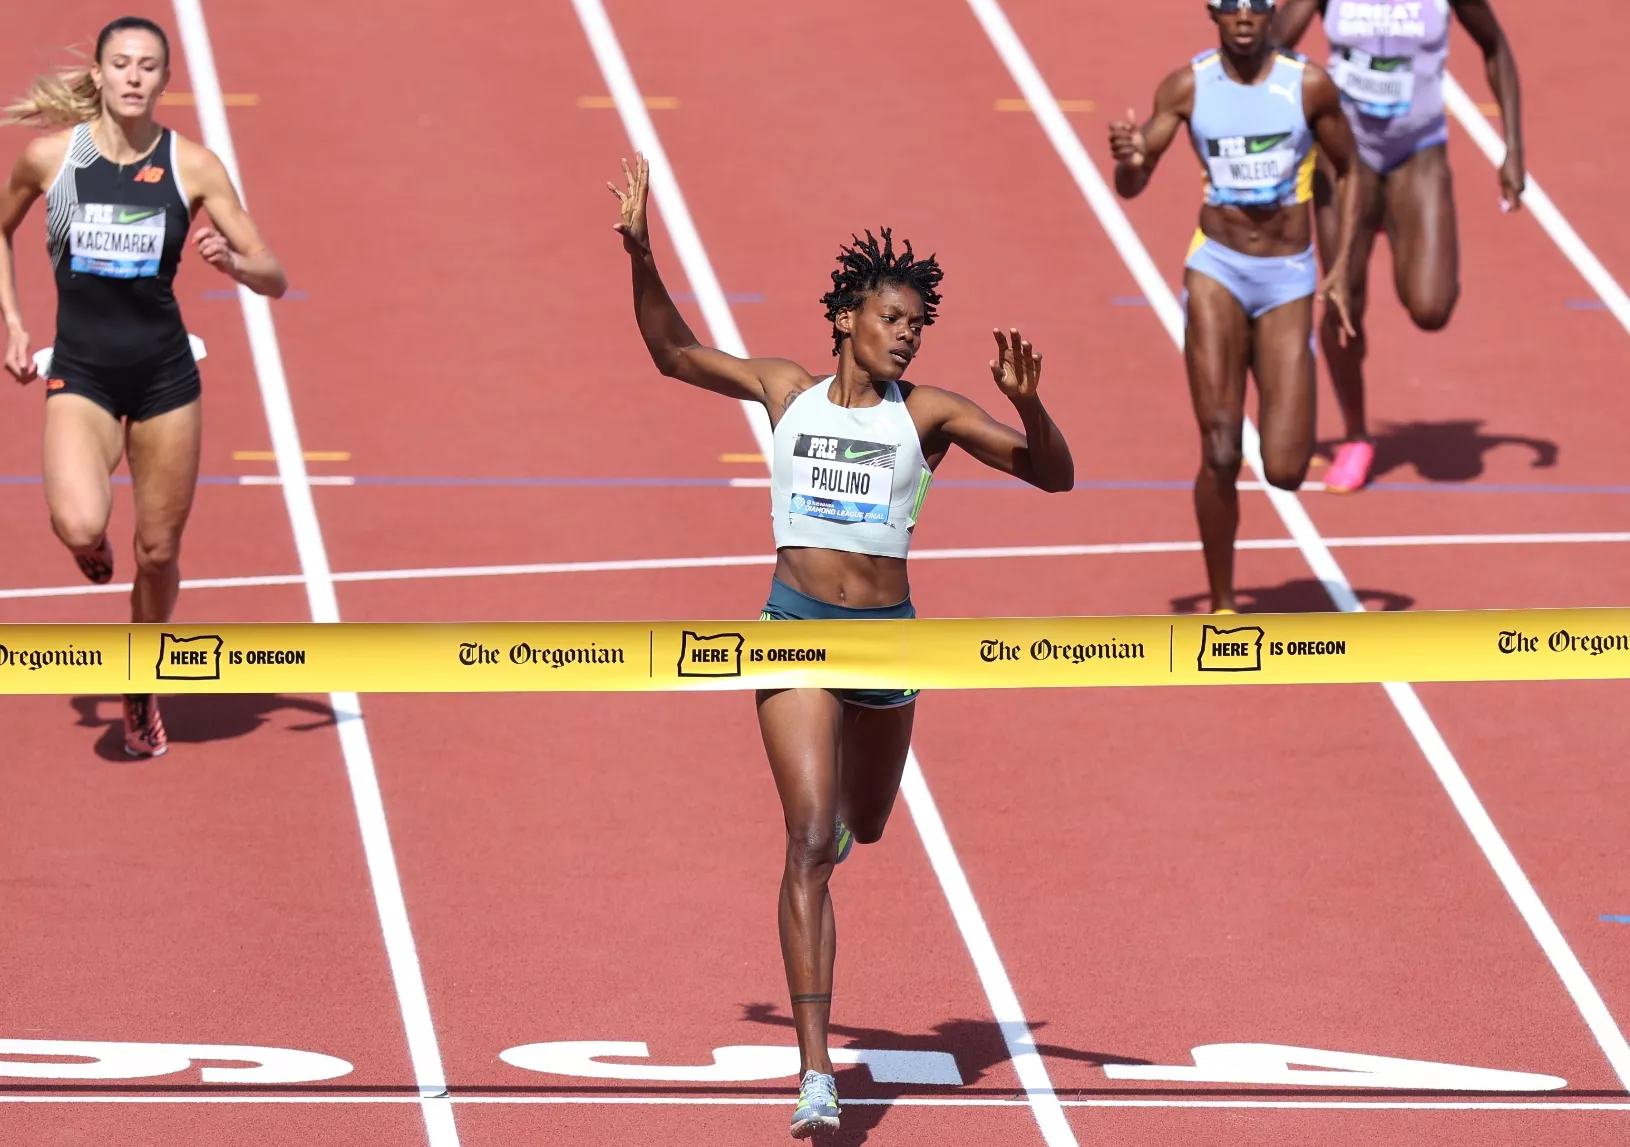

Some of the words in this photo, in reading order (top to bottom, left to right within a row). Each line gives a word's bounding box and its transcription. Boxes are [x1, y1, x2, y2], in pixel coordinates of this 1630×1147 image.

[76, 230, 157, 253] KACZMAREK
[807, 437, 838, 460] PRE
[811, 466, 871, 495] PAULINO
[805, 505, 836, 515] DIAMOND
[836, 509, 864, 518] LEAGUE
[865, 512, 885, 520] FINAL
[979, 639, 1021, 663] The
[1030, 637, 1145, 665] Oregonian
[1212, 642, 1249, 657] HERE
[1269, 641, 1284, 656] IS
[1286, 640, 1346, 656] OREGON
[1498, 630, 1539, 654] The
[1548, 629, 1630, 656] Oregon
[170, 650, 208, 665] HERE
[229, 650, 243, 665] IS
[246, 650, 306, 665] OREGON
[458, 642, 500, 665] The
[509, 642, 625, 669] Oregonian
[691, 648, 729, 663] HERE
[750, 648, 764, 662] IS
[766, 648, 826, 662] OREGON
[1103, 1043, 1567, 1091] 4
